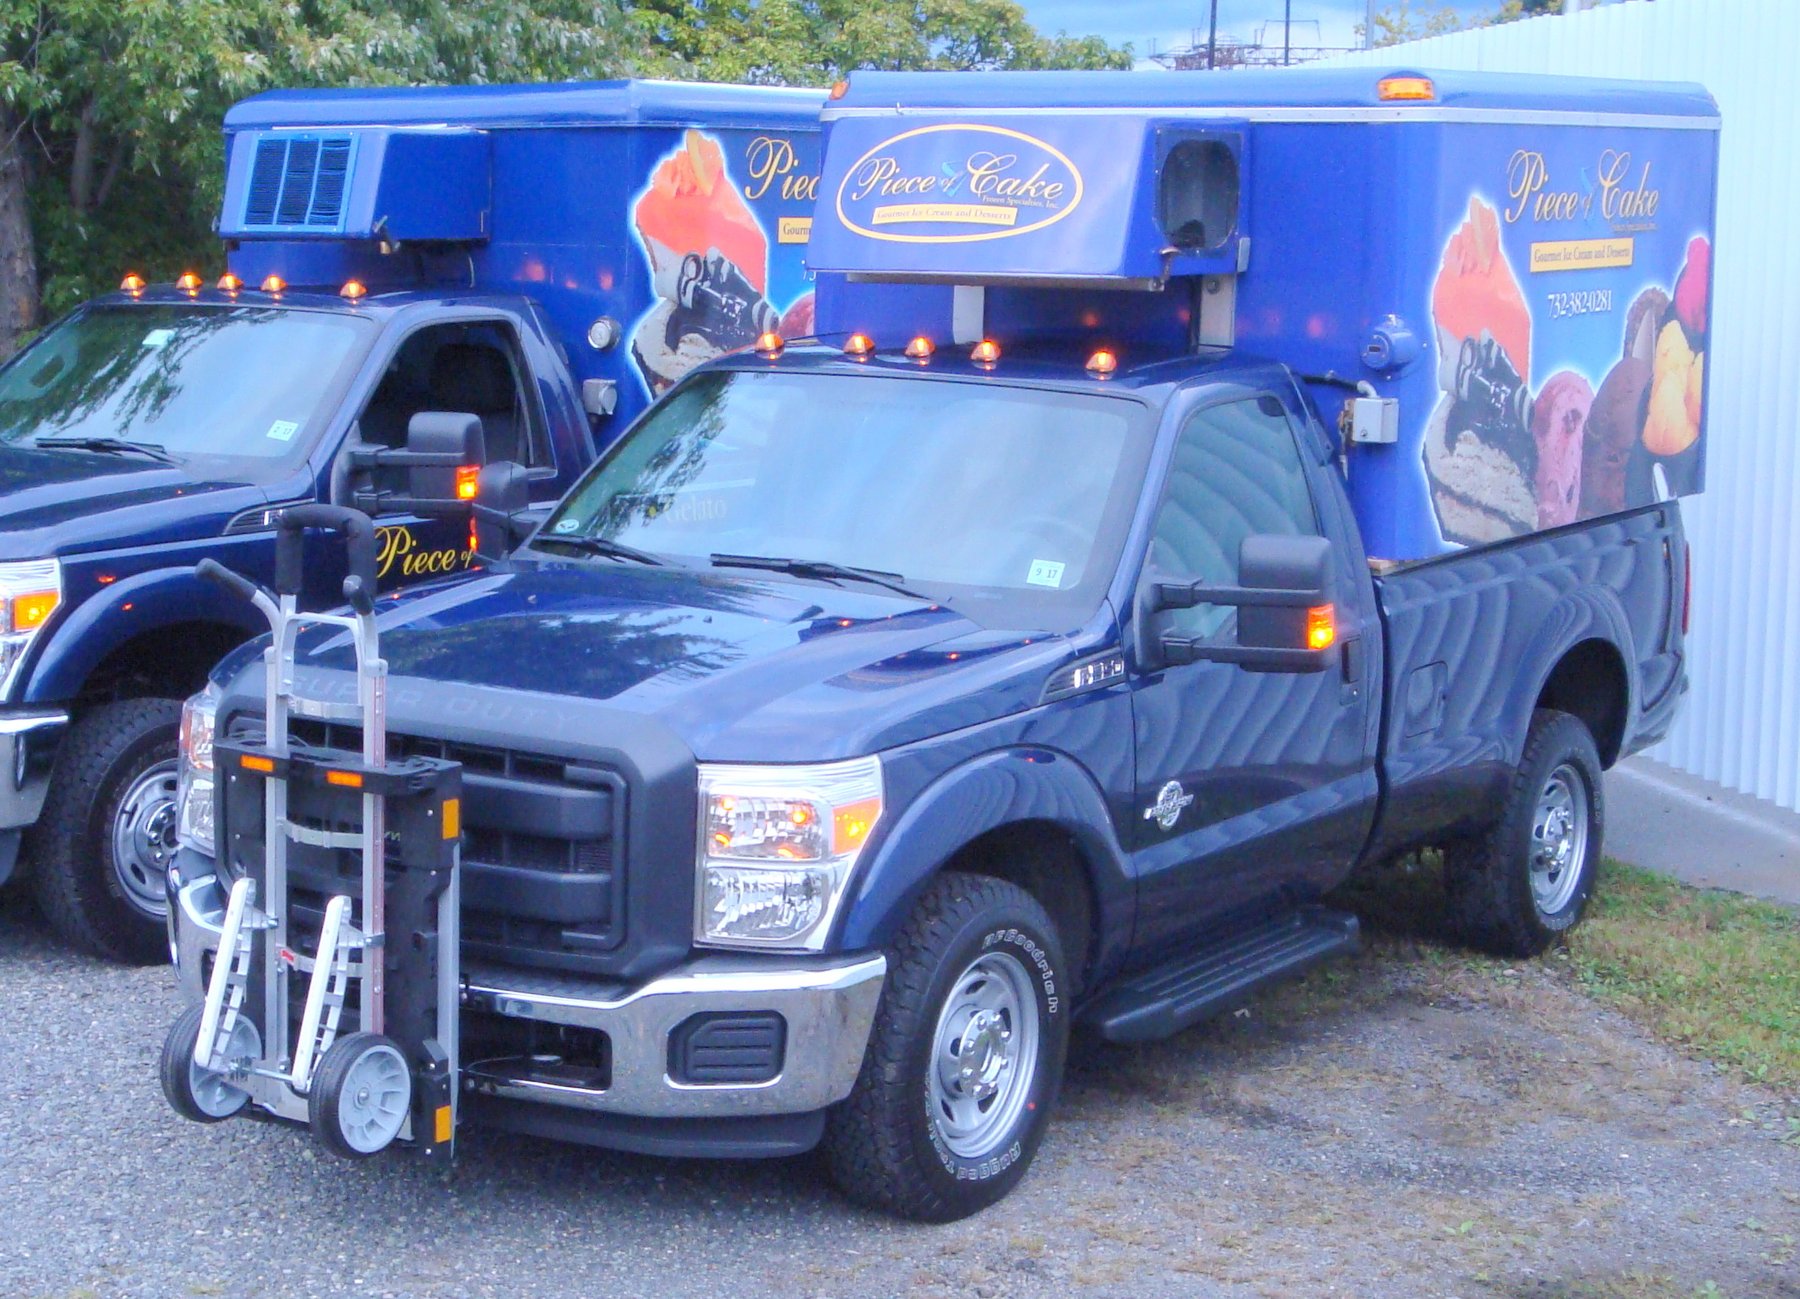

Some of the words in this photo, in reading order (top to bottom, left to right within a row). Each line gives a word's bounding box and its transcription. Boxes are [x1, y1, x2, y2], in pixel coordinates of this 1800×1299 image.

[852, 157, 936, 201] Piece
[967, 151, 1064, 200] Cake
[1505, 149, 1579, 223] Piece
[1598, 148, 1659, 222] Cake
[926, 208, 953, 217] Cream
[955, 207, 972, 217] and
[1548, 289, 1612, 319] 732-382-0281
[374, 525, 456, 578] Piece
[1035, 567, 1042, 576] 9
[1046, 569, 1058, 579] 17
